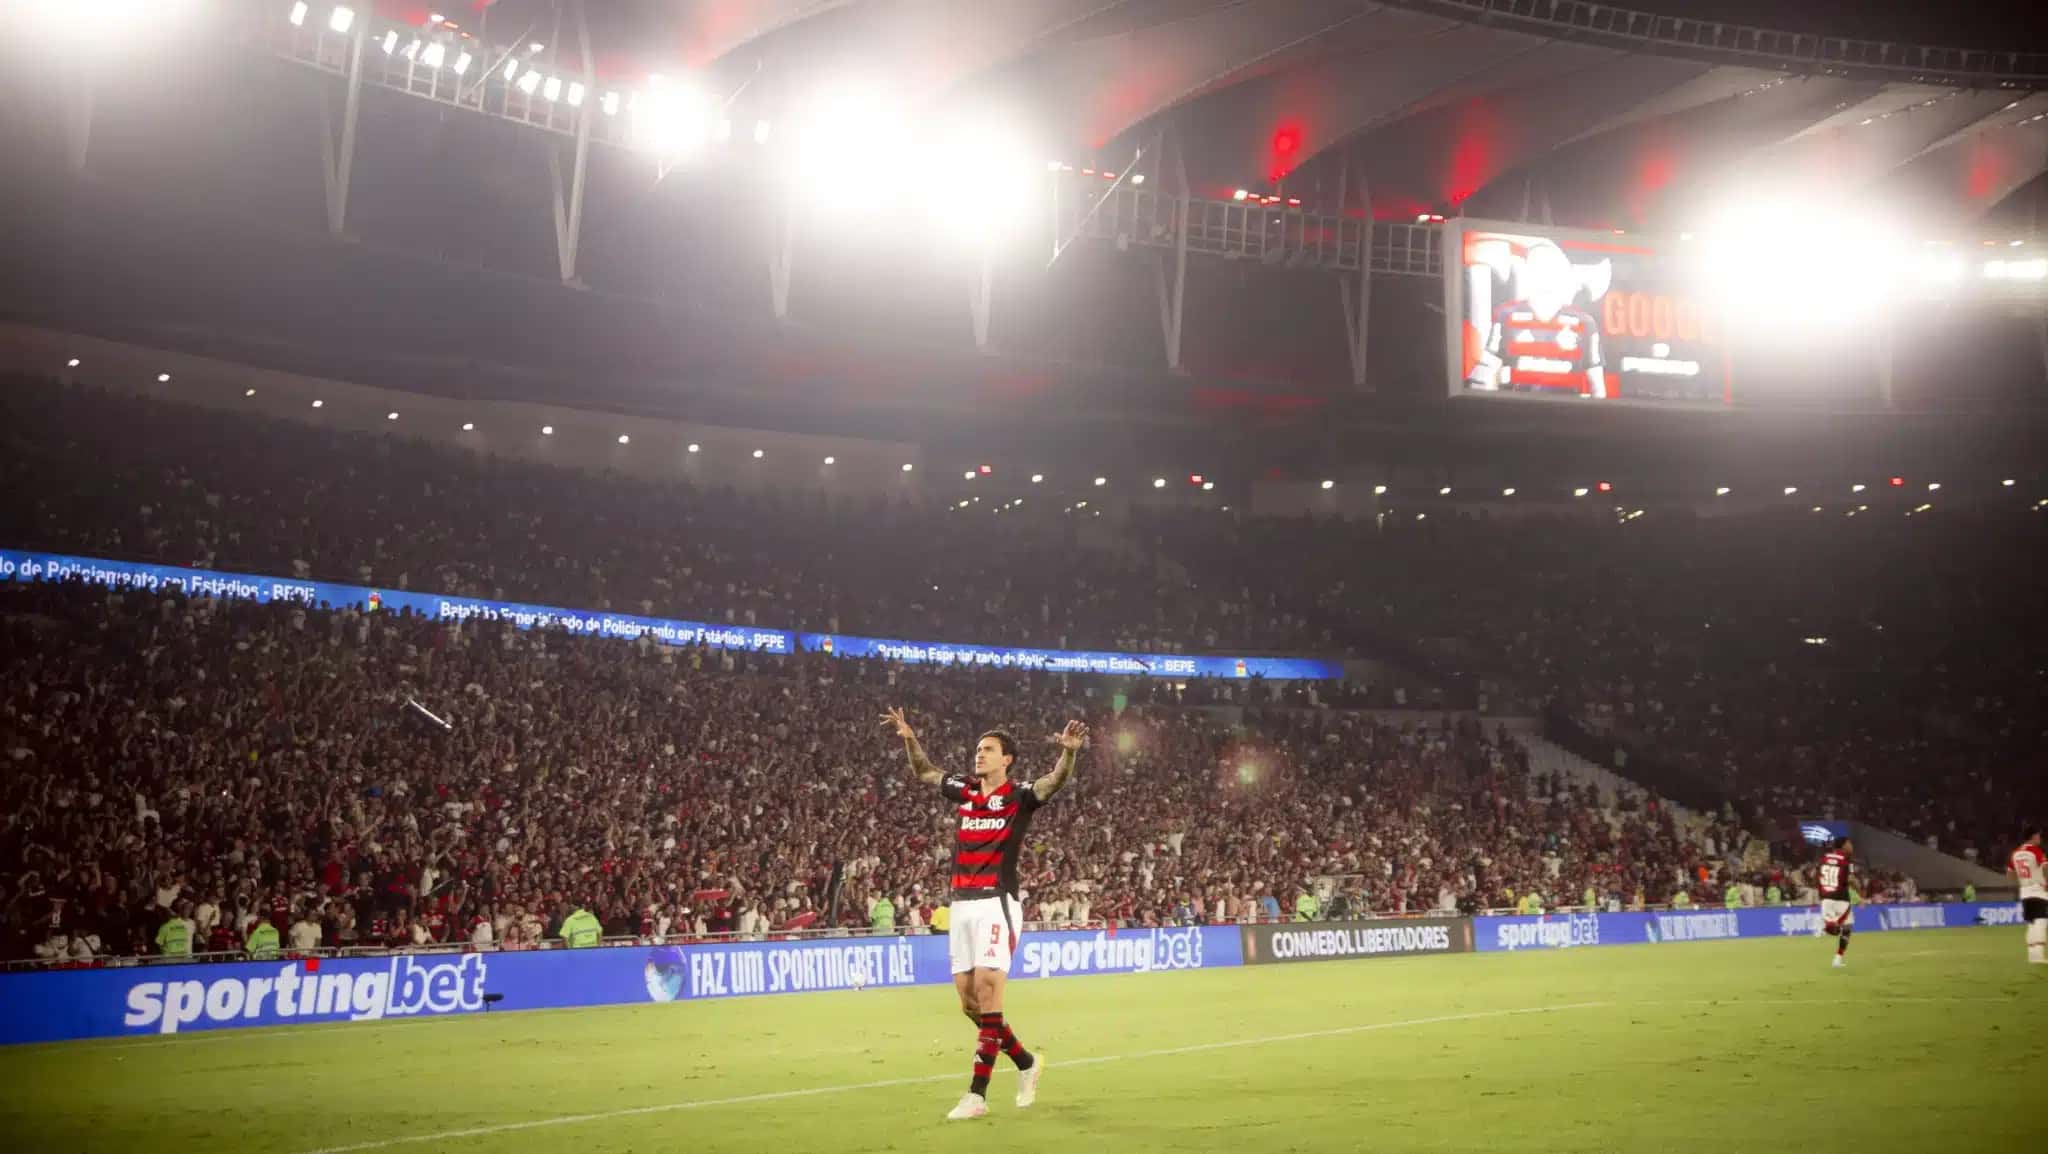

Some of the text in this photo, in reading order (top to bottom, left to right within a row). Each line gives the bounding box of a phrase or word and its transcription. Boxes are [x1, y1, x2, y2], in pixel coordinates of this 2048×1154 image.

[21, 559, 43, 577] de
[754, 633, 785, 649] BEPE
[961, 816, 1006, 830] Betano
[991, 924, 1000, 944] 9
[1271, 925, 1450, 958] CONMEBOL LIBERTADORES
[1023, 926, 1203, 978] sportingbet
[691, 952, 728, 996] FAZ
[730, 952, 765, 993] UM
[767, 945, 884, 991] SPORTINGBET
[125, 953, 486, 1034] sportingbet
